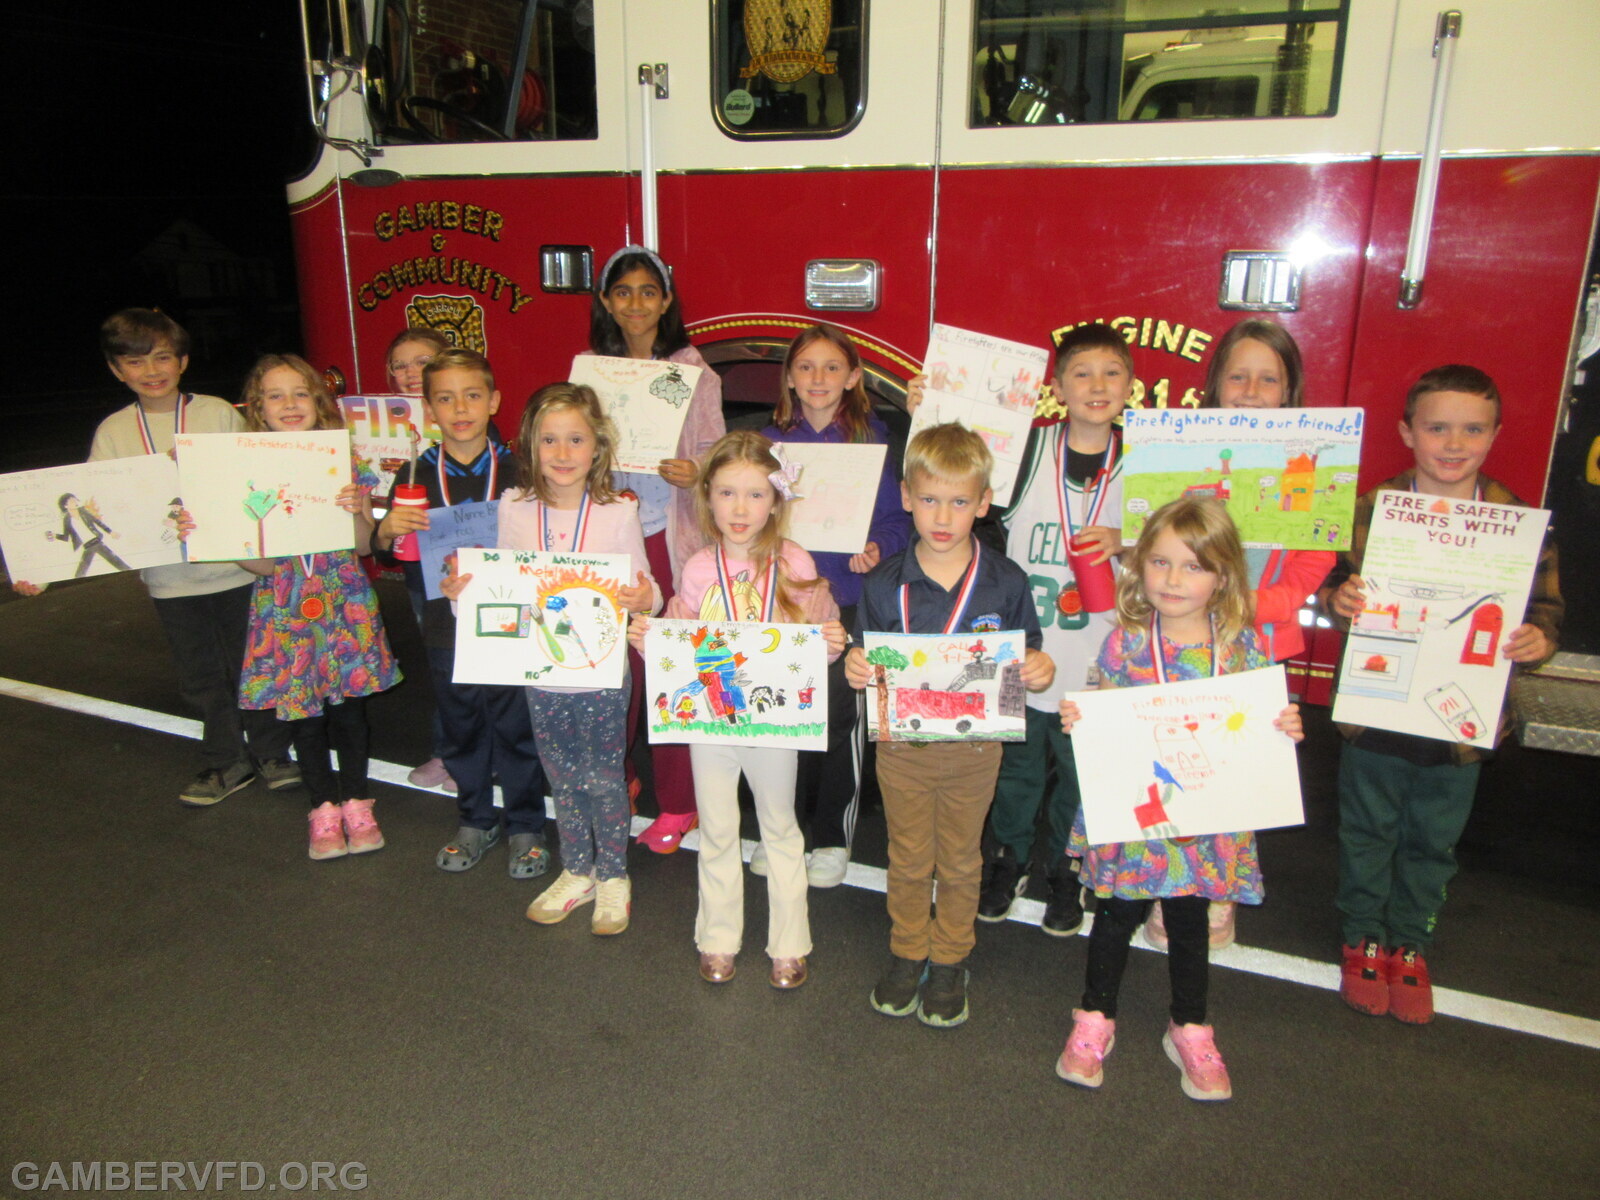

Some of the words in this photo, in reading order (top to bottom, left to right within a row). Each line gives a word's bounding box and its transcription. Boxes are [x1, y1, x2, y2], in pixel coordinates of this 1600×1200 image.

[374, 200, 505, 241] GAMBER
[431, 232, 448, 251] &
[357, 255, 534, 313] COMMUNITY
[1050, 315, 1213, 363] EGINE
[1229, 413, 1259, 429] are
[1265, 418, 1292, 429] our
[1298, 412, 1363, 436] friends!
[1382, 494, 1426, 510] FIRE
[1454, 503, 1527, 523] SAFETY
[1385, 509, 1450, 528] STARTS
[1464, 520, 1516, 536] WITH
[1427, 530, 1477, 549] YOU!
[1439, 696, 1460, 716] 911
